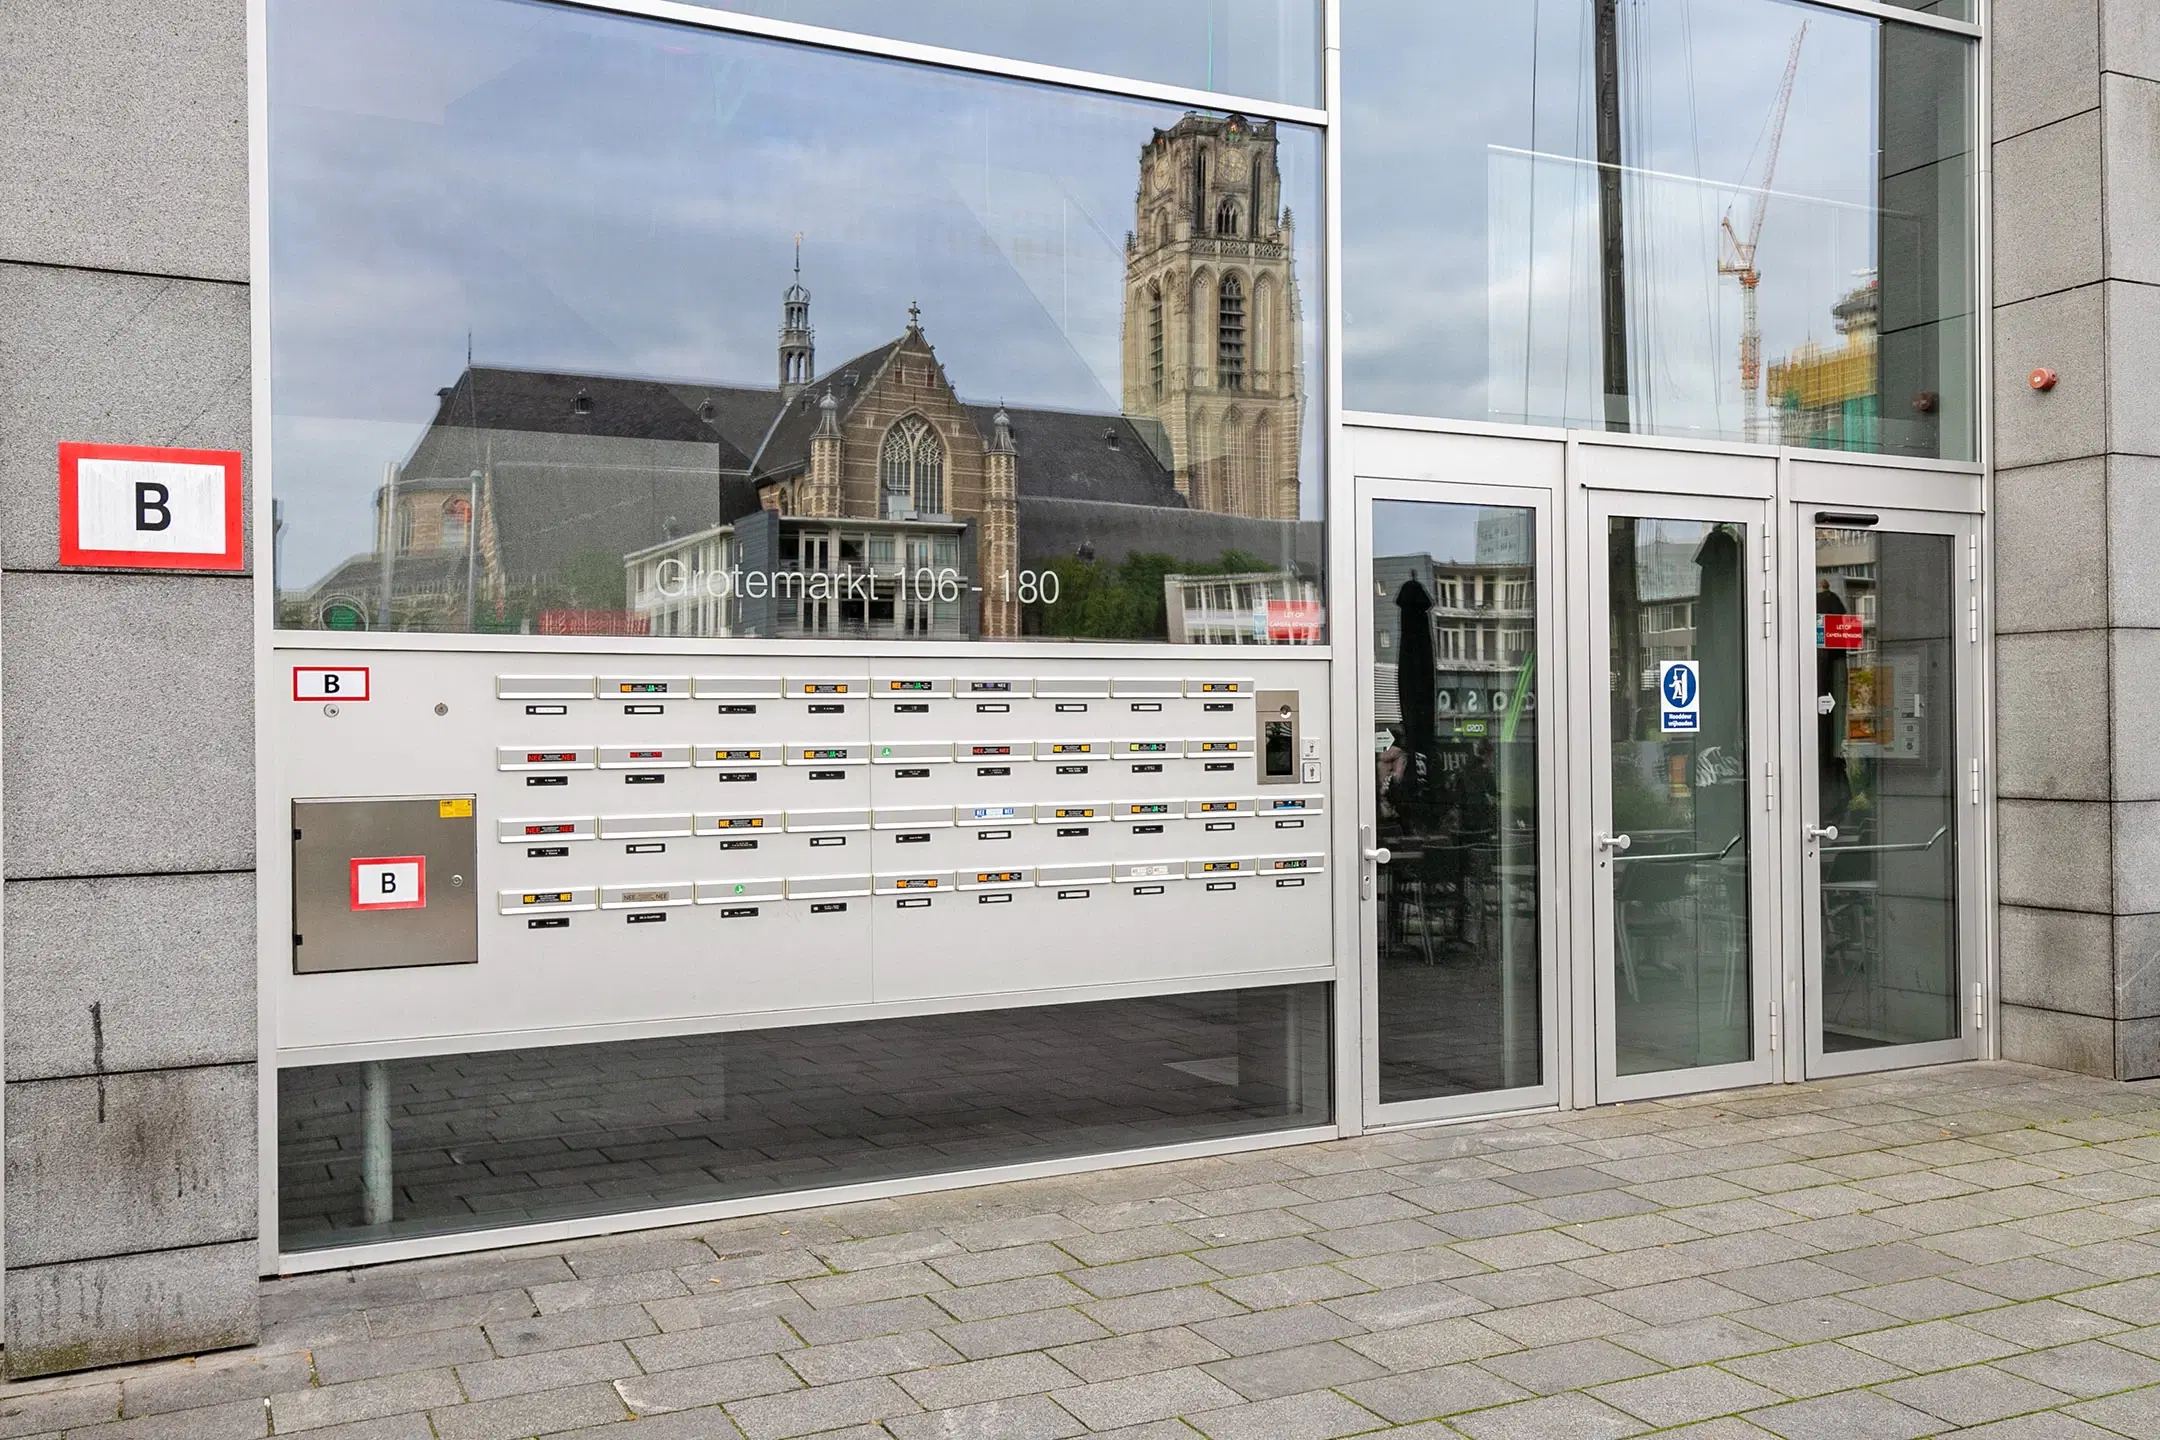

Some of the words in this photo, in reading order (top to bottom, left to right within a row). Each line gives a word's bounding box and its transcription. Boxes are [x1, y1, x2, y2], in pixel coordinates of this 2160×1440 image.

[135, 482, 171, 531] B
[654, 559, 878, 600] Grotemarkt
[895, 567, 959, 602] 106
[999, 569, 1059, 604] 180
[324, 674, 340, 693] B
[382, 873, 397, 893] B
